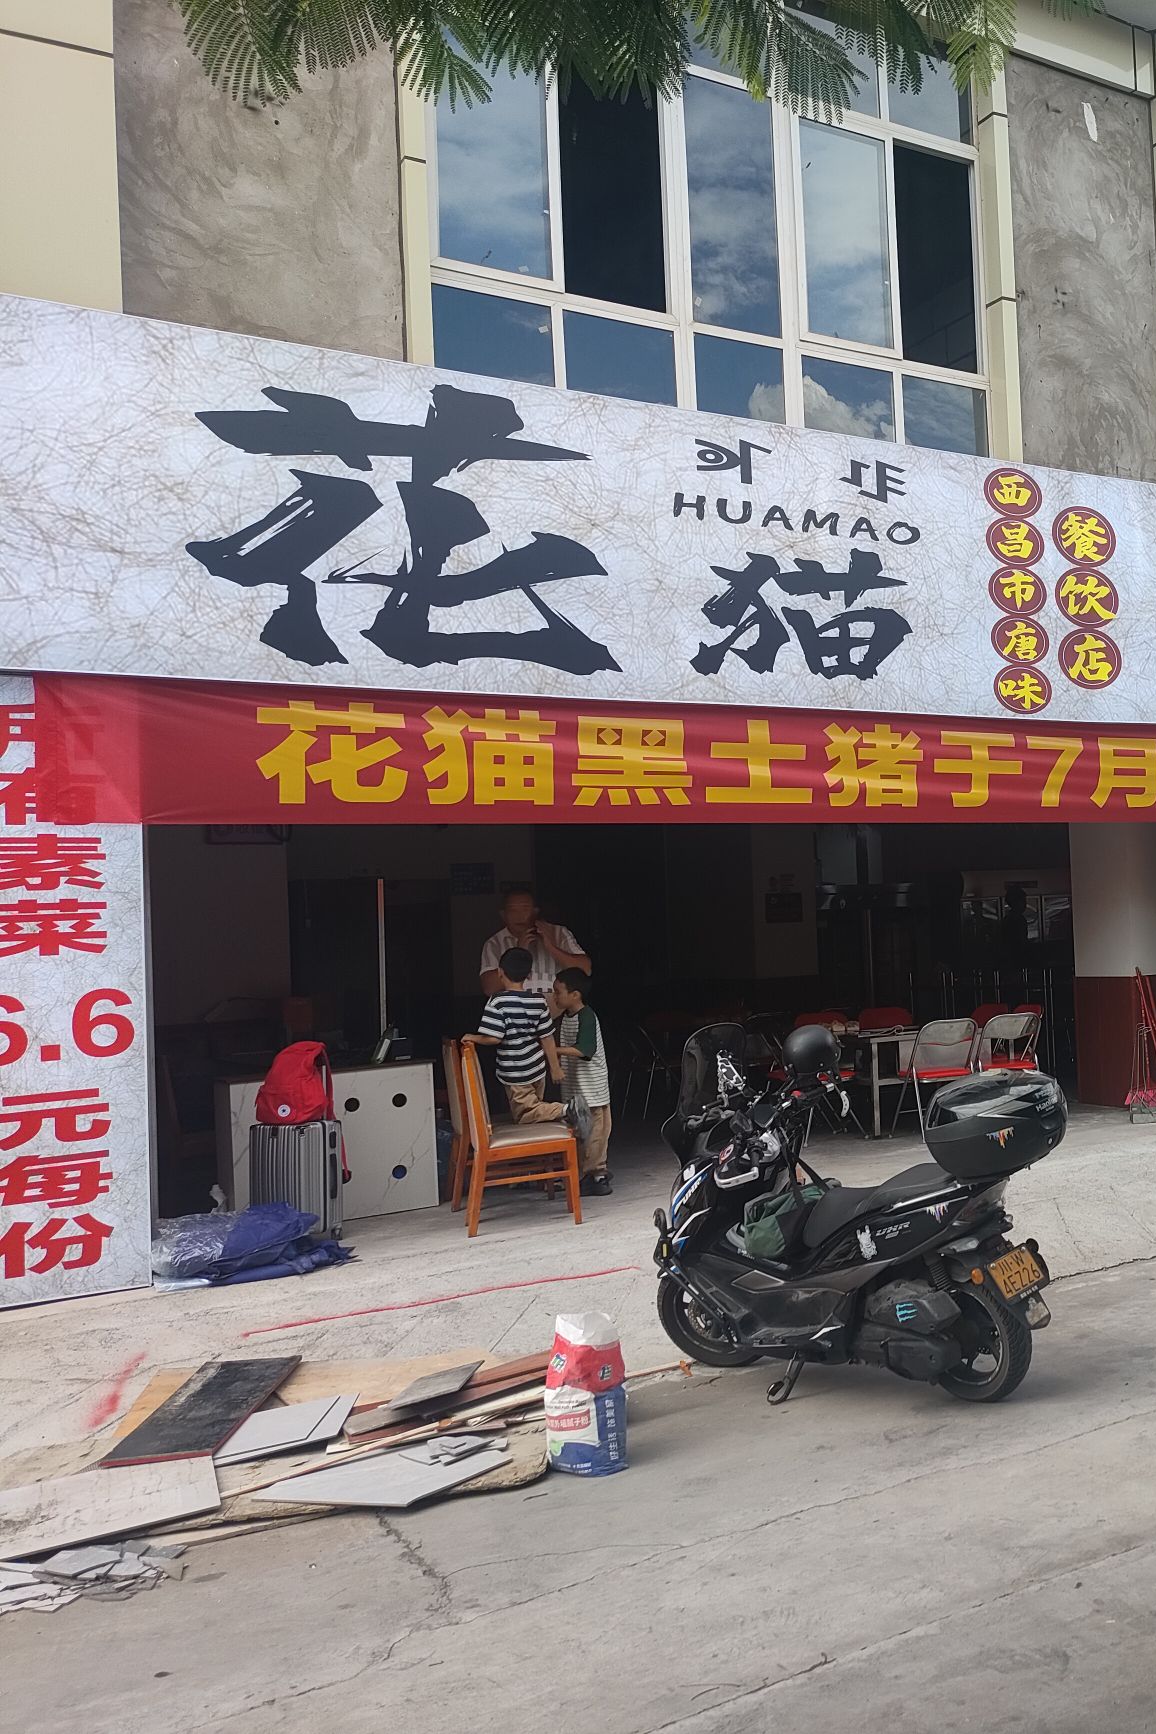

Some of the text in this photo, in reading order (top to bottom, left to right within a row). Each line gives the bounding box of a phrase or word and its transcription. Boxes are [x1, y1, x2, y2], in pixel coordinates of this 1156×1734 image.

[185, 384, 913, 681] 花猫
[673, 492, 921, 546] HUAMAO
[1060, 512, 1117, 681] 餐饮店
